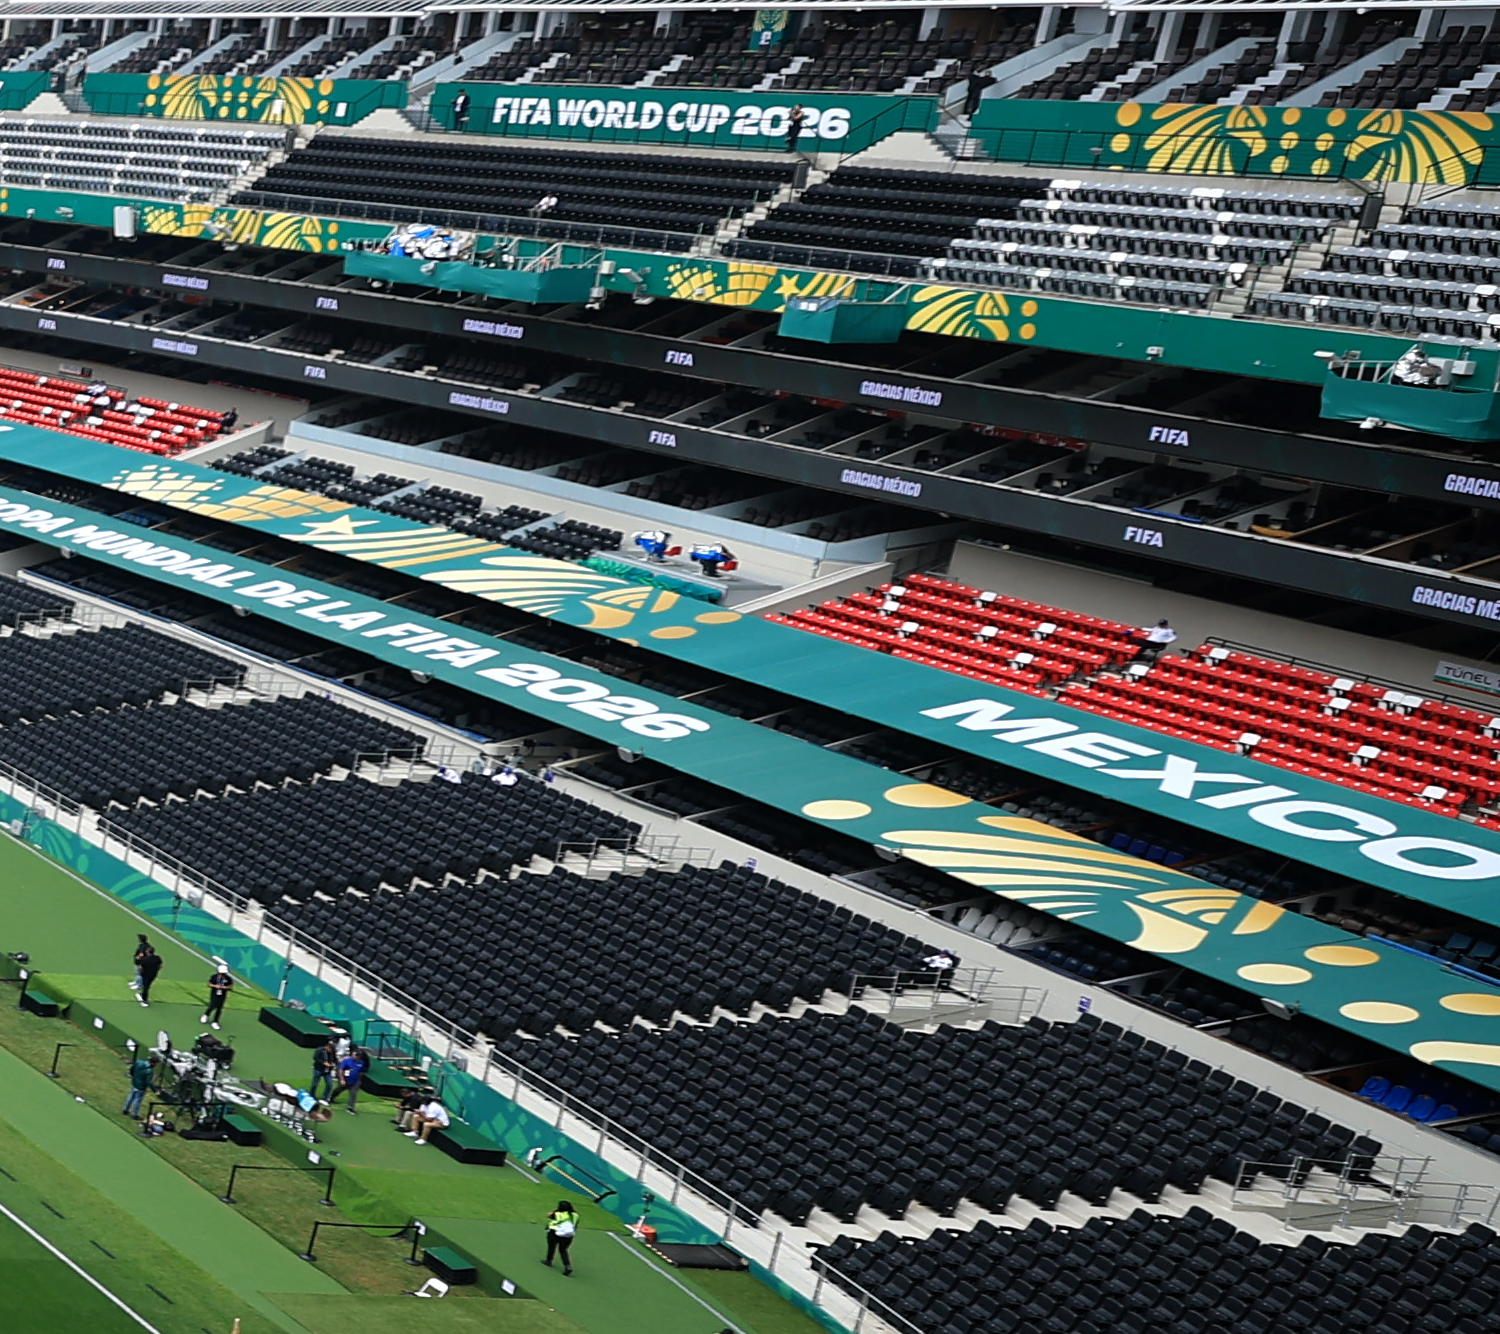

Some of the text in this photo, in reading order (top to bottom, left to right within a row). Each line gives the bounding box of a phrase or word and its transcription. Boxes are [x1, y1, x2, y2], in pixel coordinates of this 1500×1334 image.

[492, 96, 851, 141] FIFA WORLD CUP 2026
[666, 351, 693, 366] FIFA
[861, 381, 941, 406] GRACIAS MÉXICO
[649, 431, 676, 447] FIFA
[1149, 427, 1188, 446] FIFA
[841, 469, 921, 497] GRACIAS MÉXICO
[1124, 527, 1163, 547] FIFA
[1412, 587, 1475, 615] GRACIAS
[53, 525, 255, 588] MUNDIAL
[233, 580, 329, 608] DE
[296, 600, 387, 631] LA
[360, 617, 501, 668] FIFA
[476, 663, 710, 739] 2026
[1443, 665, 1492, 685] TÚNEL
[920, 698, 1500, 881] MEXICO
